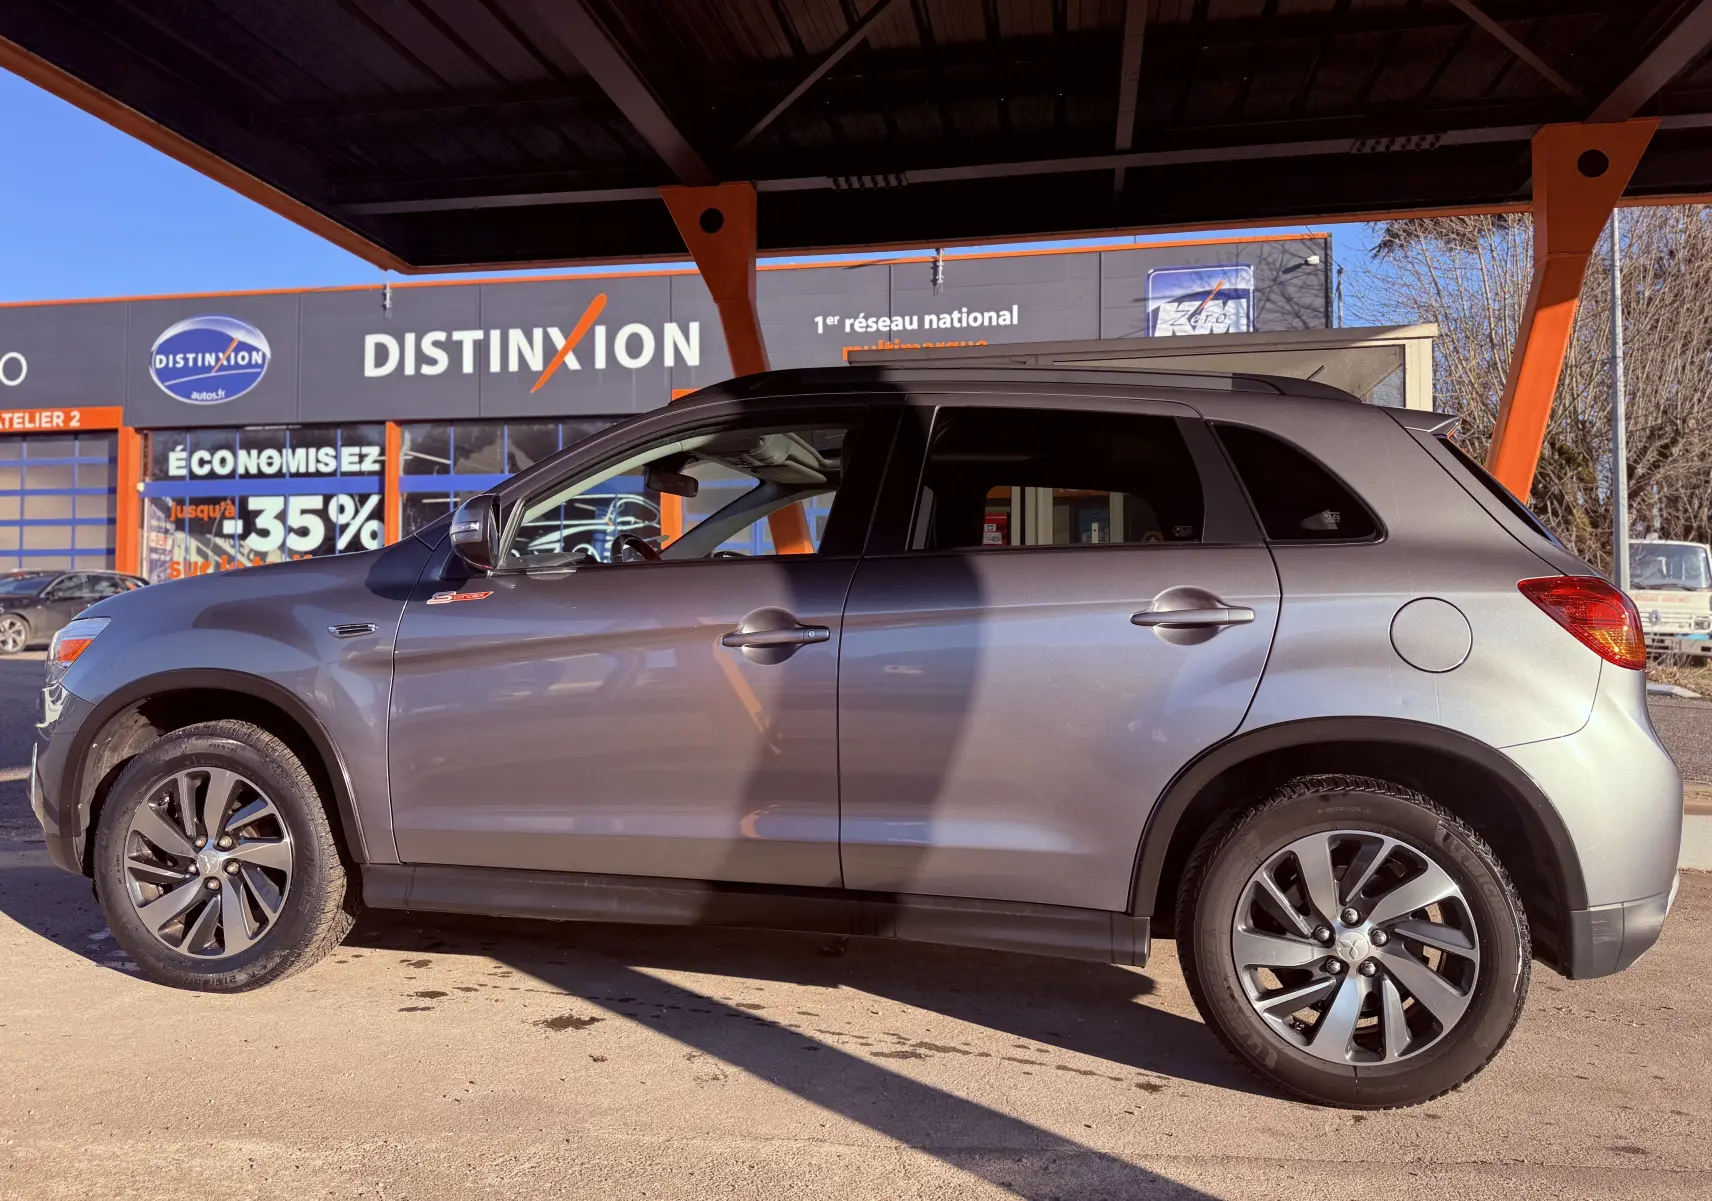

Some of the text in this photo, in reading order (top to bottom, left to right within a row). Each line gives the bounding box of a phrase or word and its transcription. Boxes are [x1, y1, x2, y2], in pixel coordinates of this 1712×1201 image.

[845, 313, 918, 333] réseau
[924, 305, 1019, 329] national
[155, 340, 263, 373] DISTINXION
[364, 293, 700, 393] DISTINXION
[191, 388, 226, 401] autos.fr
[0, 411, 81, 430] TELIER 2
[168, 446, 381, 476] ÉCONOMISEZ
[169, 502, 236, 522] jusqu'à
[222, 494, 384, 552] -35%
